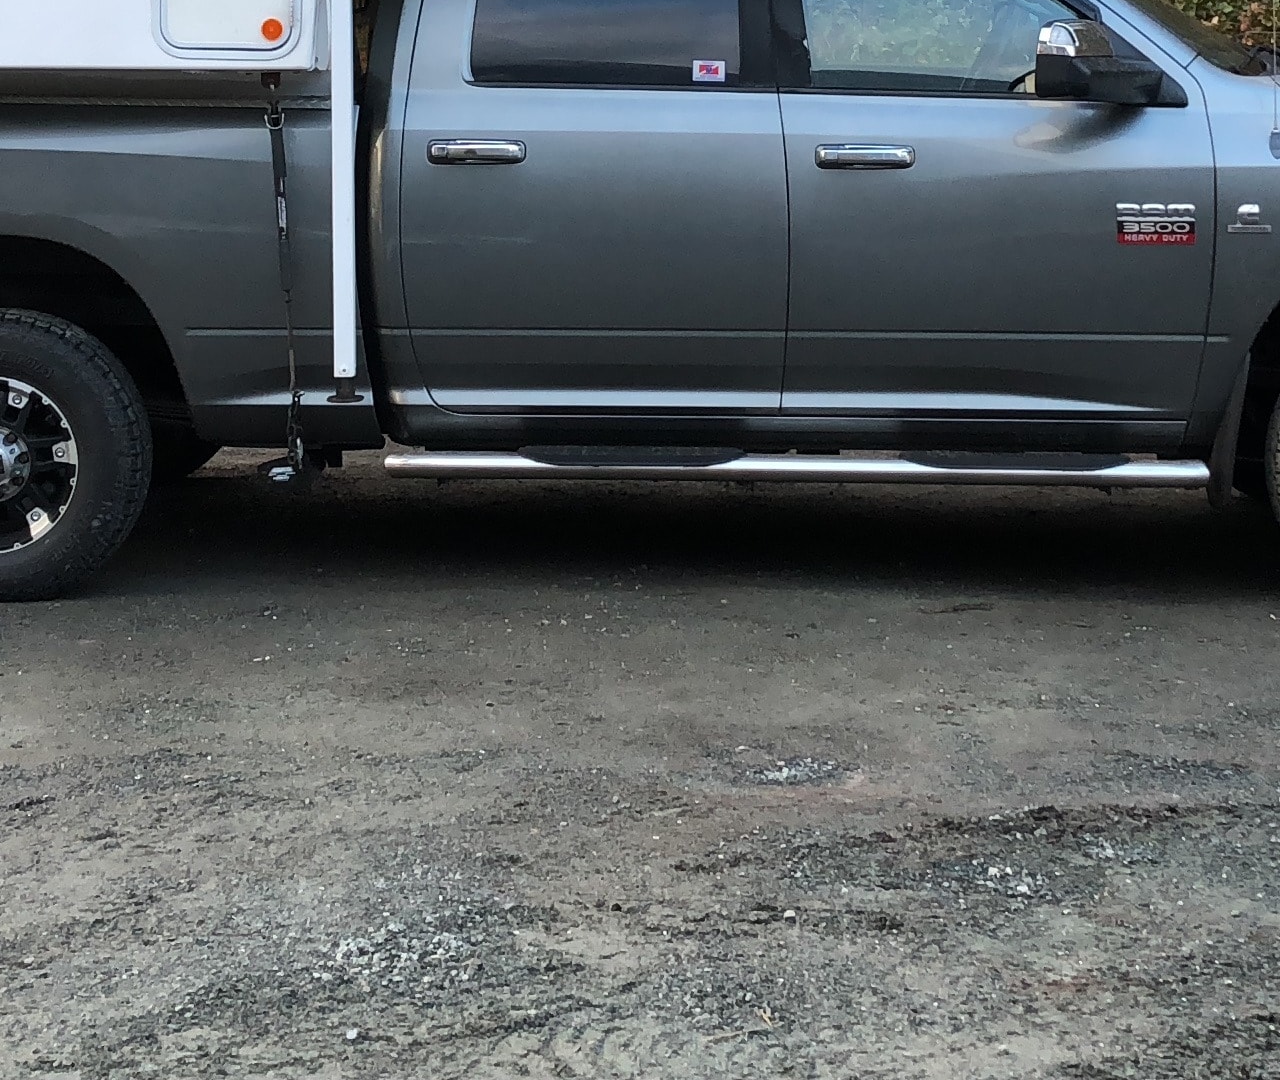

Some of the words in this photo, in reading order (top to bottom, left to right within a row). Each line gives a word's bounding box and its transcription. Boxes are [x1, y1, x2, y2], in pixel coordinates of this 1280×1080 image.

[1122, 222, 1191, 233] 3500
[1124, 234, 1159, 243] HEAVY
[1162, 234, 1189, 243] DUTY
